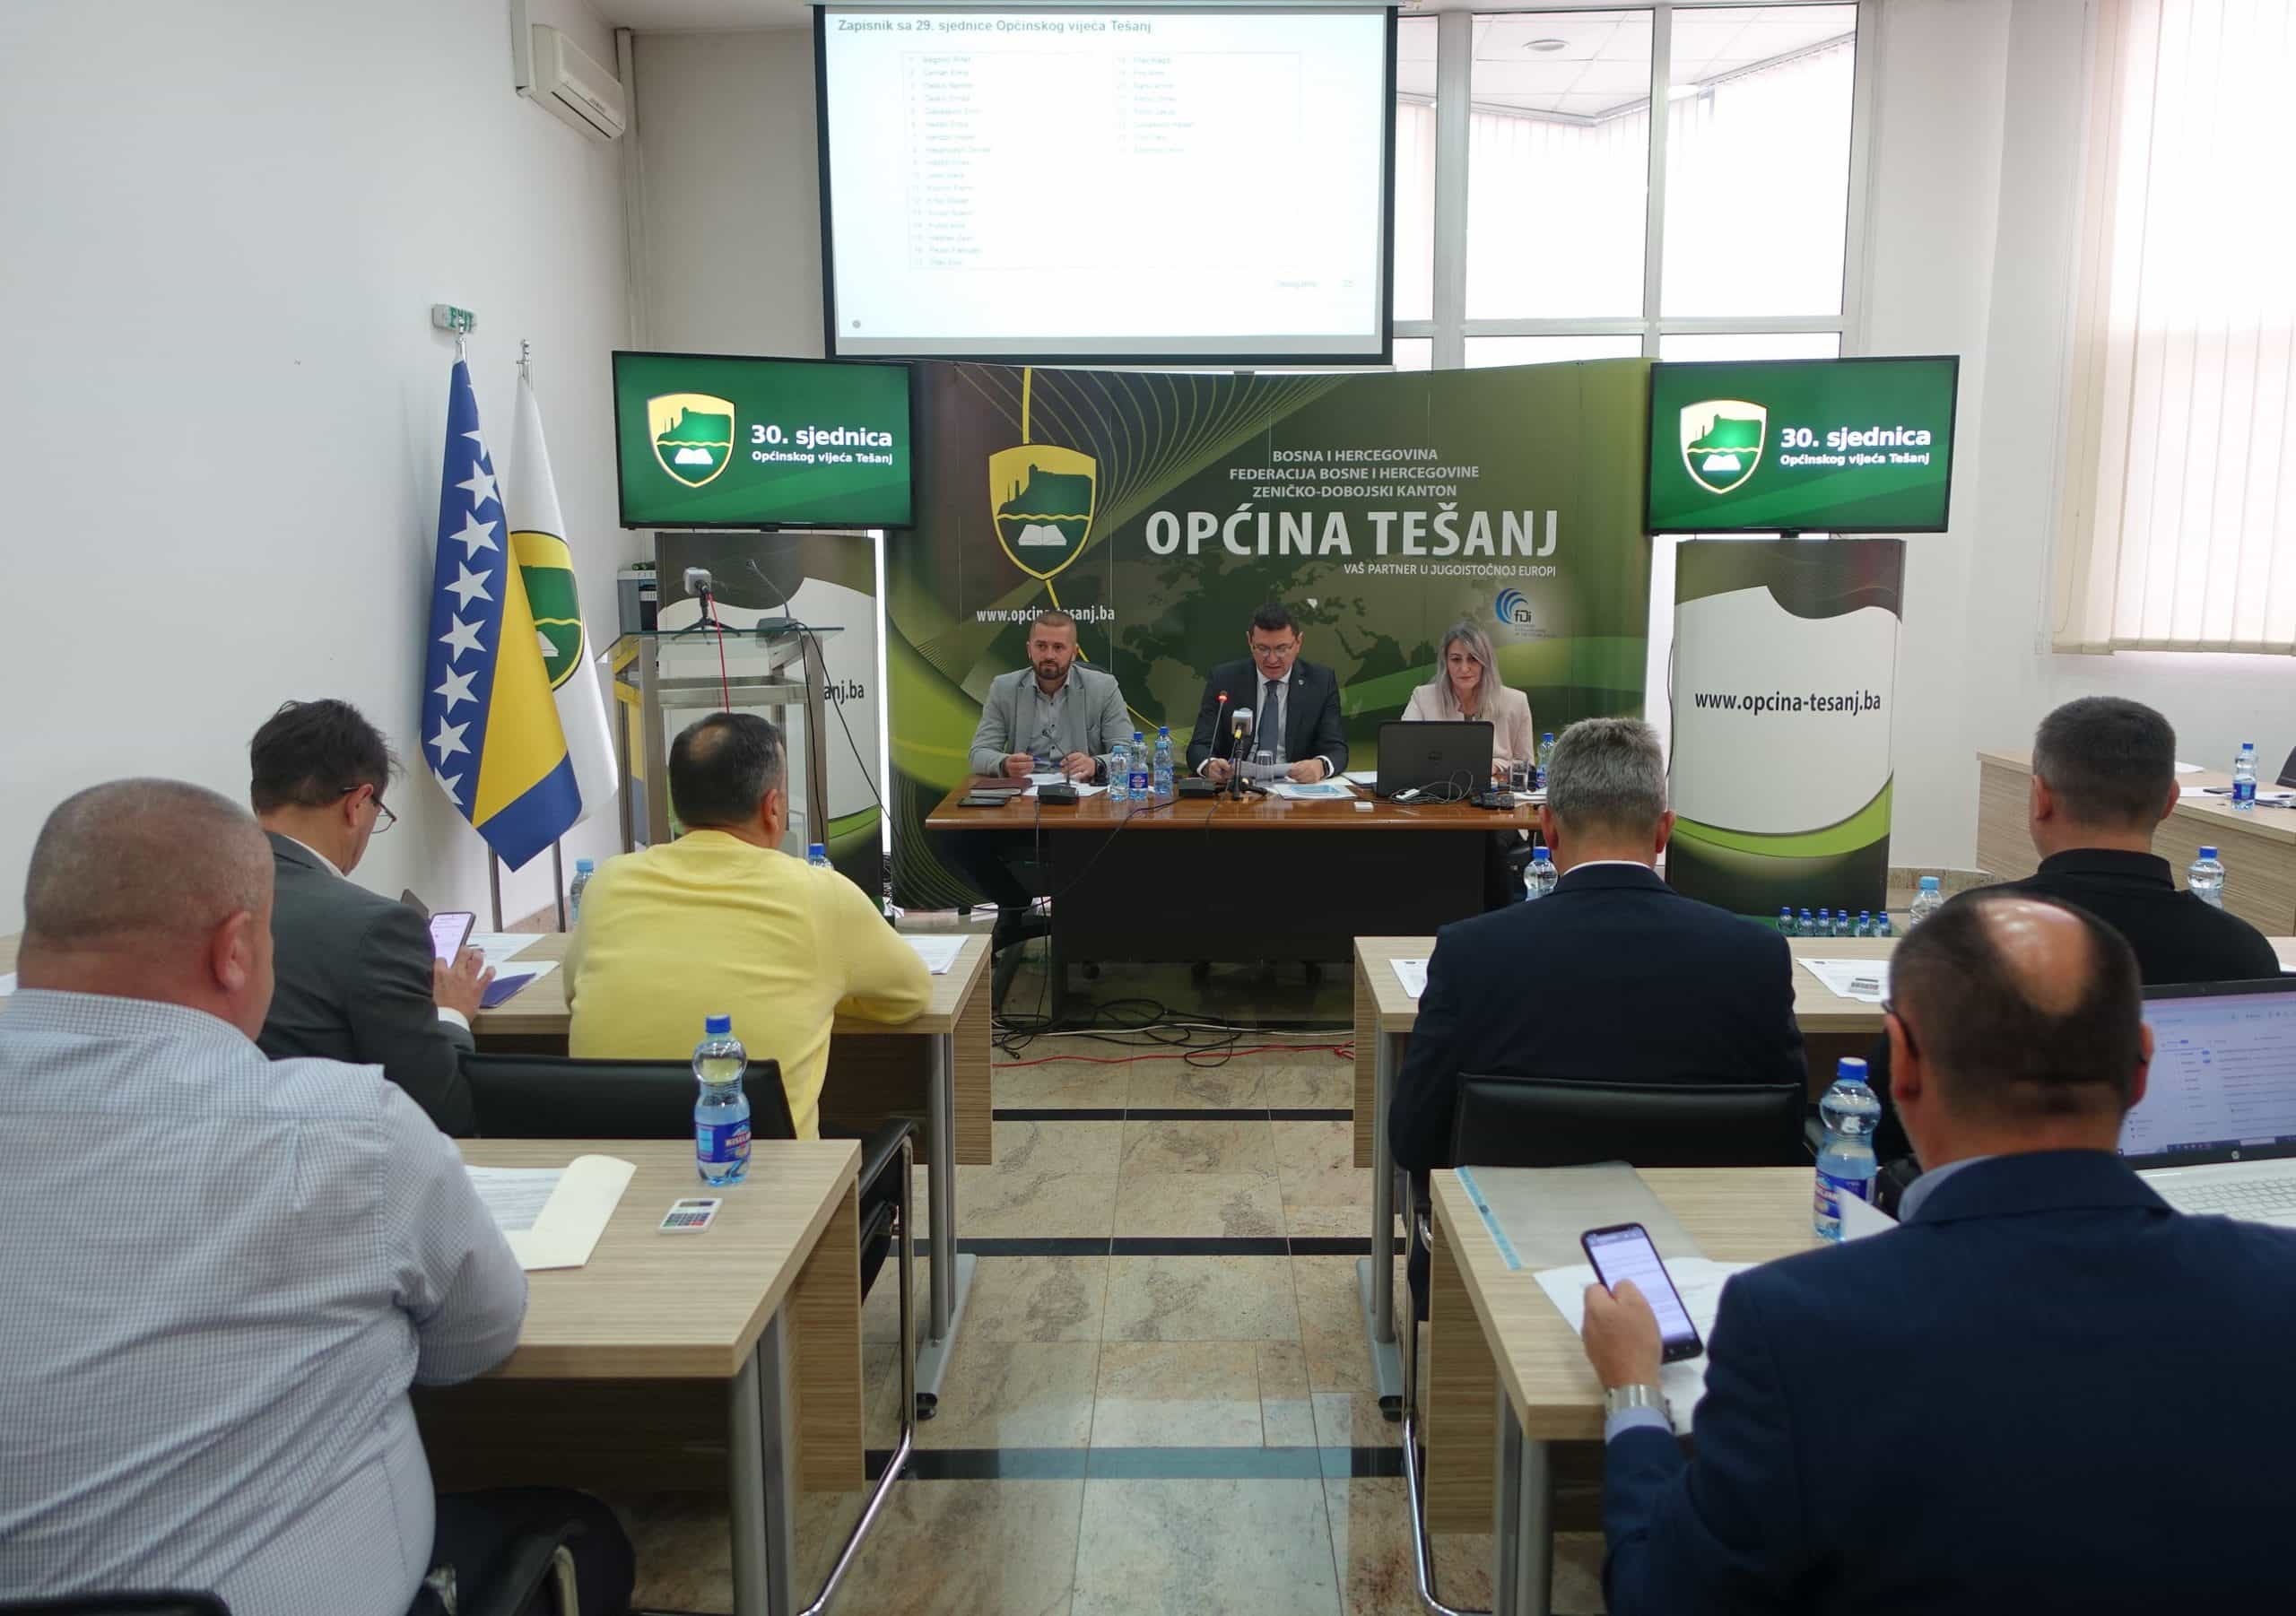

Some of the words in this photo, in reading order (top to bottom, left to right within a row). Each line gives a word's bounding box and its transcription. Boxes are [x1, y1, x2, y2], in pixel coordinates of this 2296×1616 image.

[838, 20, 893, 33] Zapisnik
[897, 22, 913, 31] sa
[916, 20, 935, 31] 29.
[938, 20, 992, 33] sjednice
[1111, 20, 1152, 34] Tešanj
[751, 424, 789, 444] 30.
[796, 425, 892, 449] sjednica
[1780, 427, 1820, 447] 30.
[1826, 426, 1932, 451] sjednica
[752, 450, 815, 464] Općinskog
[818, 452, 853, 464] vijeća
[856, 453, 893, 465] Tešanj
[1273, 450, 1324, 462] BOSNA
[1326, 450, 1331, 461] I
[1335, 448, 1439, 461] HERCEGOVINA
[1780, 454, 1846, 466] Općinskog
[1848, 453, 1886, 465] vijeća
[1889, 452, 1930, 465] Tešanj
[1230, 467, 1317, 480] FEDERACIJA
[1319, 467, 1369, 480] BOSNE
[1372, 467, 1376, 479] I
[1379, 466, 1479, 479] HERCEGOVINE
[1252, 483, 1393, 498] ZENIČKO-DOBOJSKI
[1397, 485, 1457, 497] KANTON
[1145, 503, 1352, 556] OPĆINA
[1368, 502, 1558, 557] TEŠANJ
[1344, 561, 1365, 574] VAŠ
[1368, 563, 1417, 575] PARTNER
[1420, 564, 1428, 575] U
[1431, 562, 1516, 576] JUGOISTOČNOJ
[1518, 566, 1556, 577] EUROPI
[976, 605, 1116, 625] www.opcinsanj.ba
[1694, 690, 1882, 716] www.opcina-tesanj.ba
